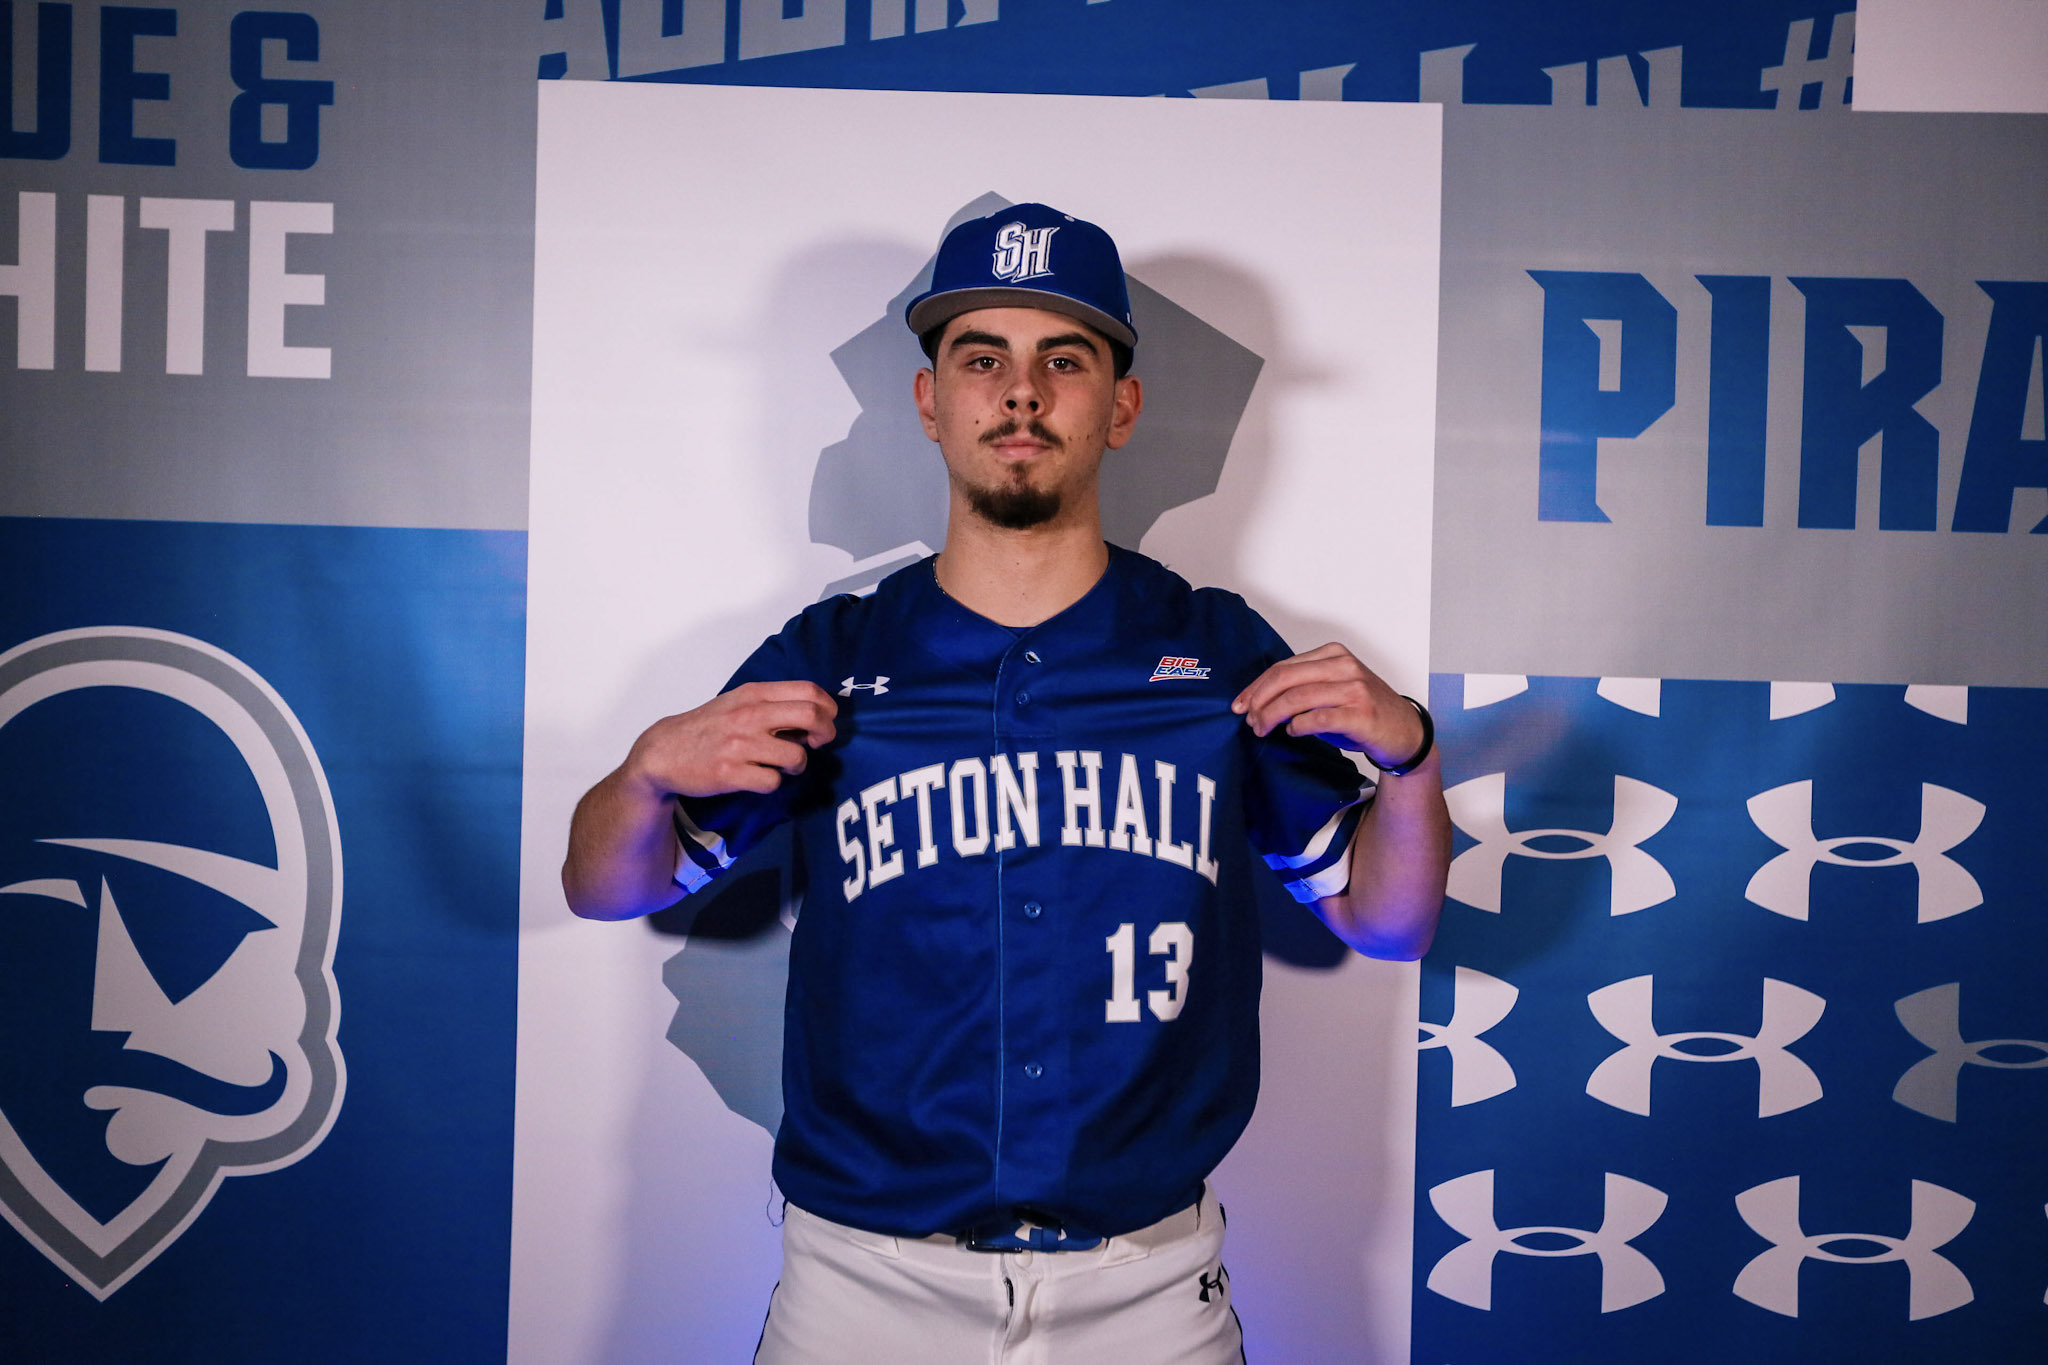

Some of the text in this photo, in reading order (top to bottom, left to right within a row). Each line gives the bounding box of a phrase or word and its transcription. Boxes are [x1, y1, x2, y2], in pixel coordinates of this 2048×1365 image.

[229, 11, 334, 170] &
[992, 221, 1060, 283] SH
[1153, 666, 1211, 677] EAST
[1159, 656, 1199, 668] BIG
[836, 750, 1219, 903] SETON HALL
[1105, 921, 1194, 1023] 13
